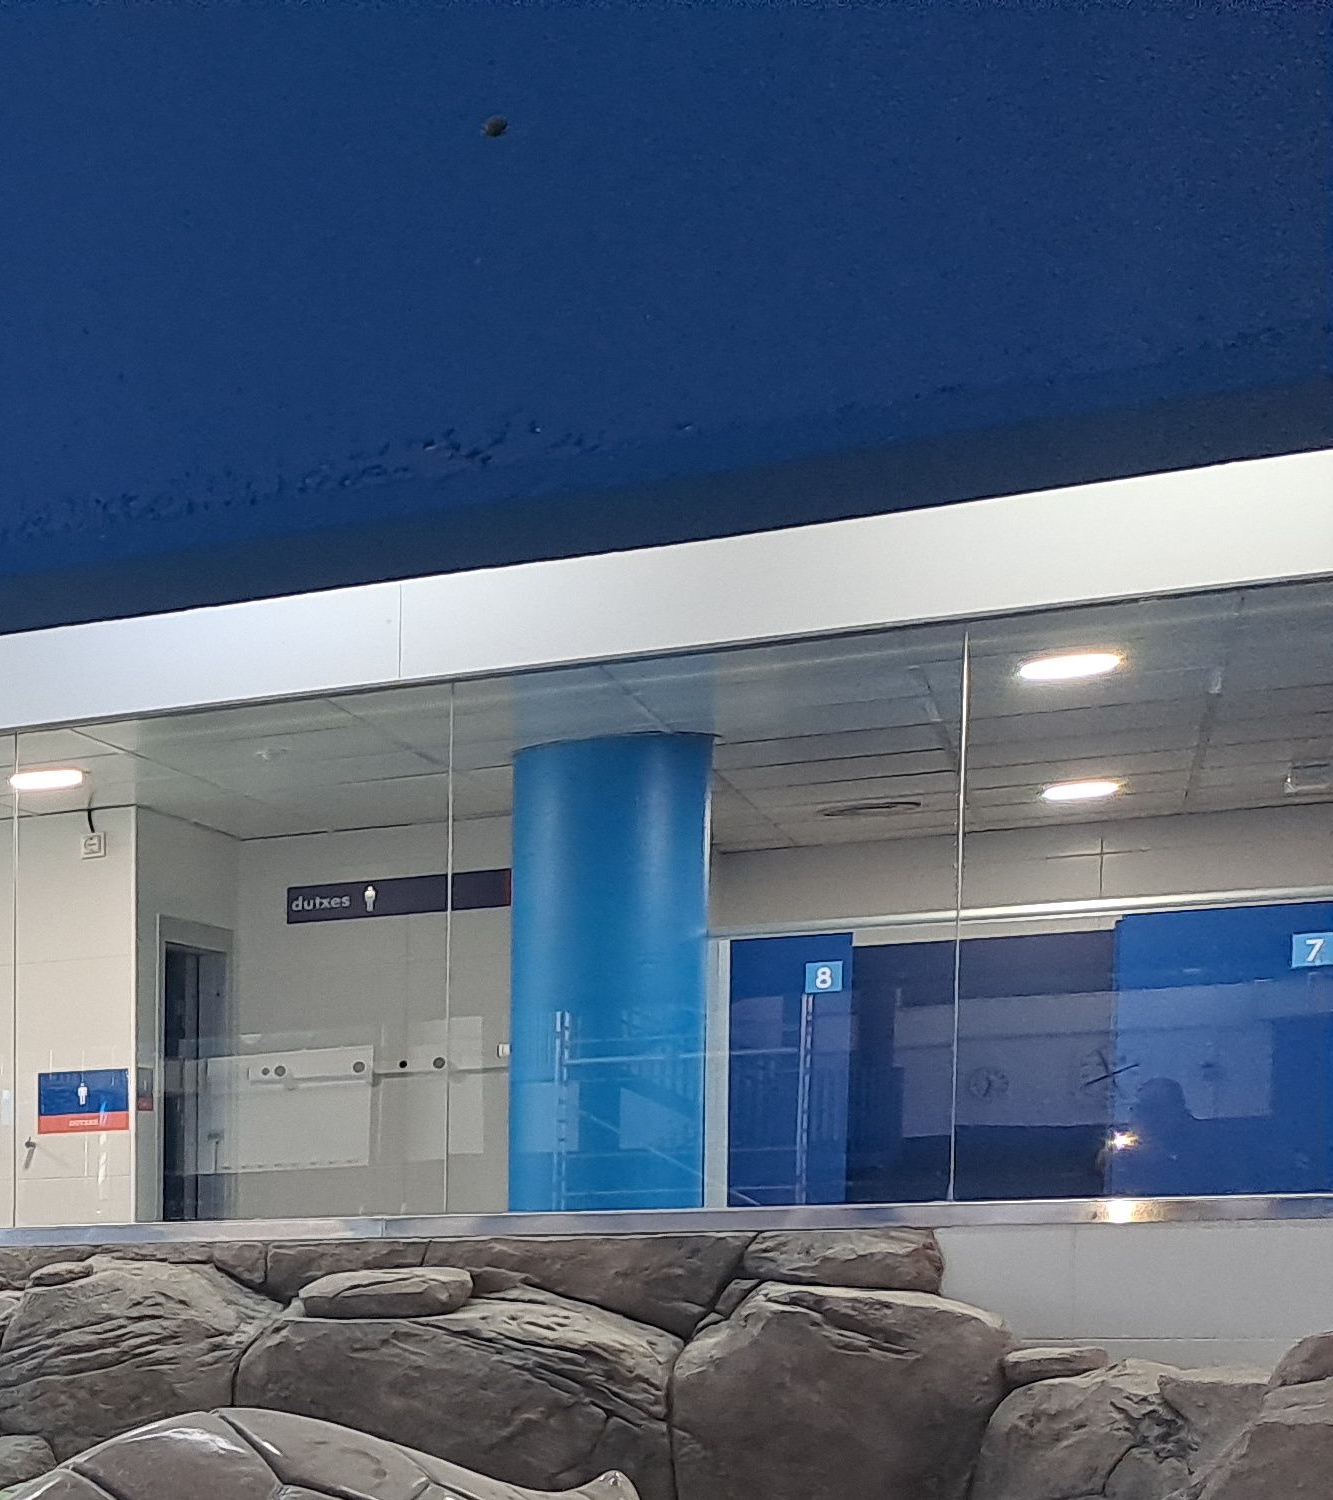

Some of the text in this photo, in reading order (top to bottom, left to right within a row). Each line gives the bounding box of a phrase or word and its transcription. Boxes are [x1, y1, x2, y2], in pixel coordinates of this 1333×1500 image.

[291, 895, 350, 911] dutxes
[1305, 938, 1324, 962] 7
[815, 966, 832, 989] 8
